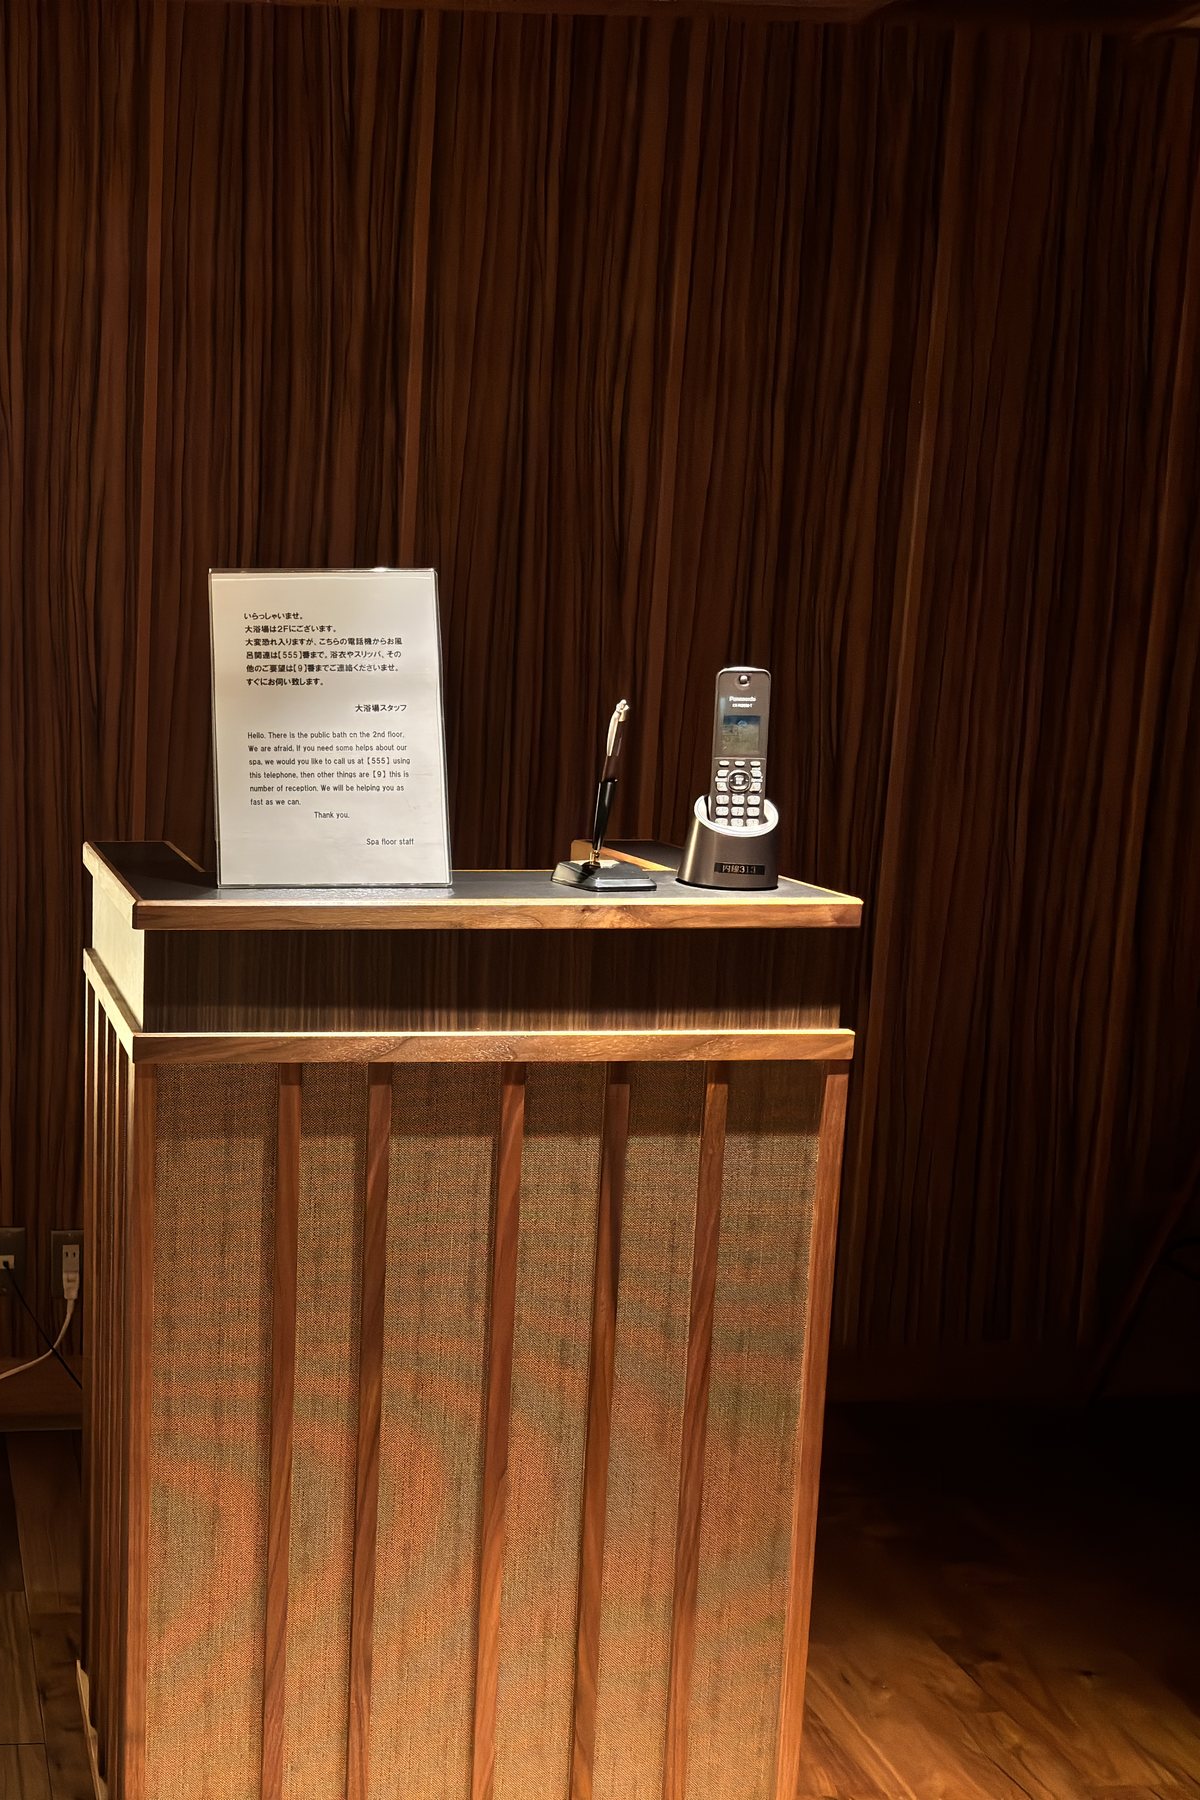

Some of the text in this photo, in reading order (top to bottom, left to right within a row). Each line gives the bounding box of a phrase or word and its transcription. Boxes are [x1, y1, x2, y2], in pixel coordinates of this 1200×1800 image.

[244, 612, 303, 620] いらっしゃいませ。
[355, 704, 407, 712] 大浴場スタッフ
